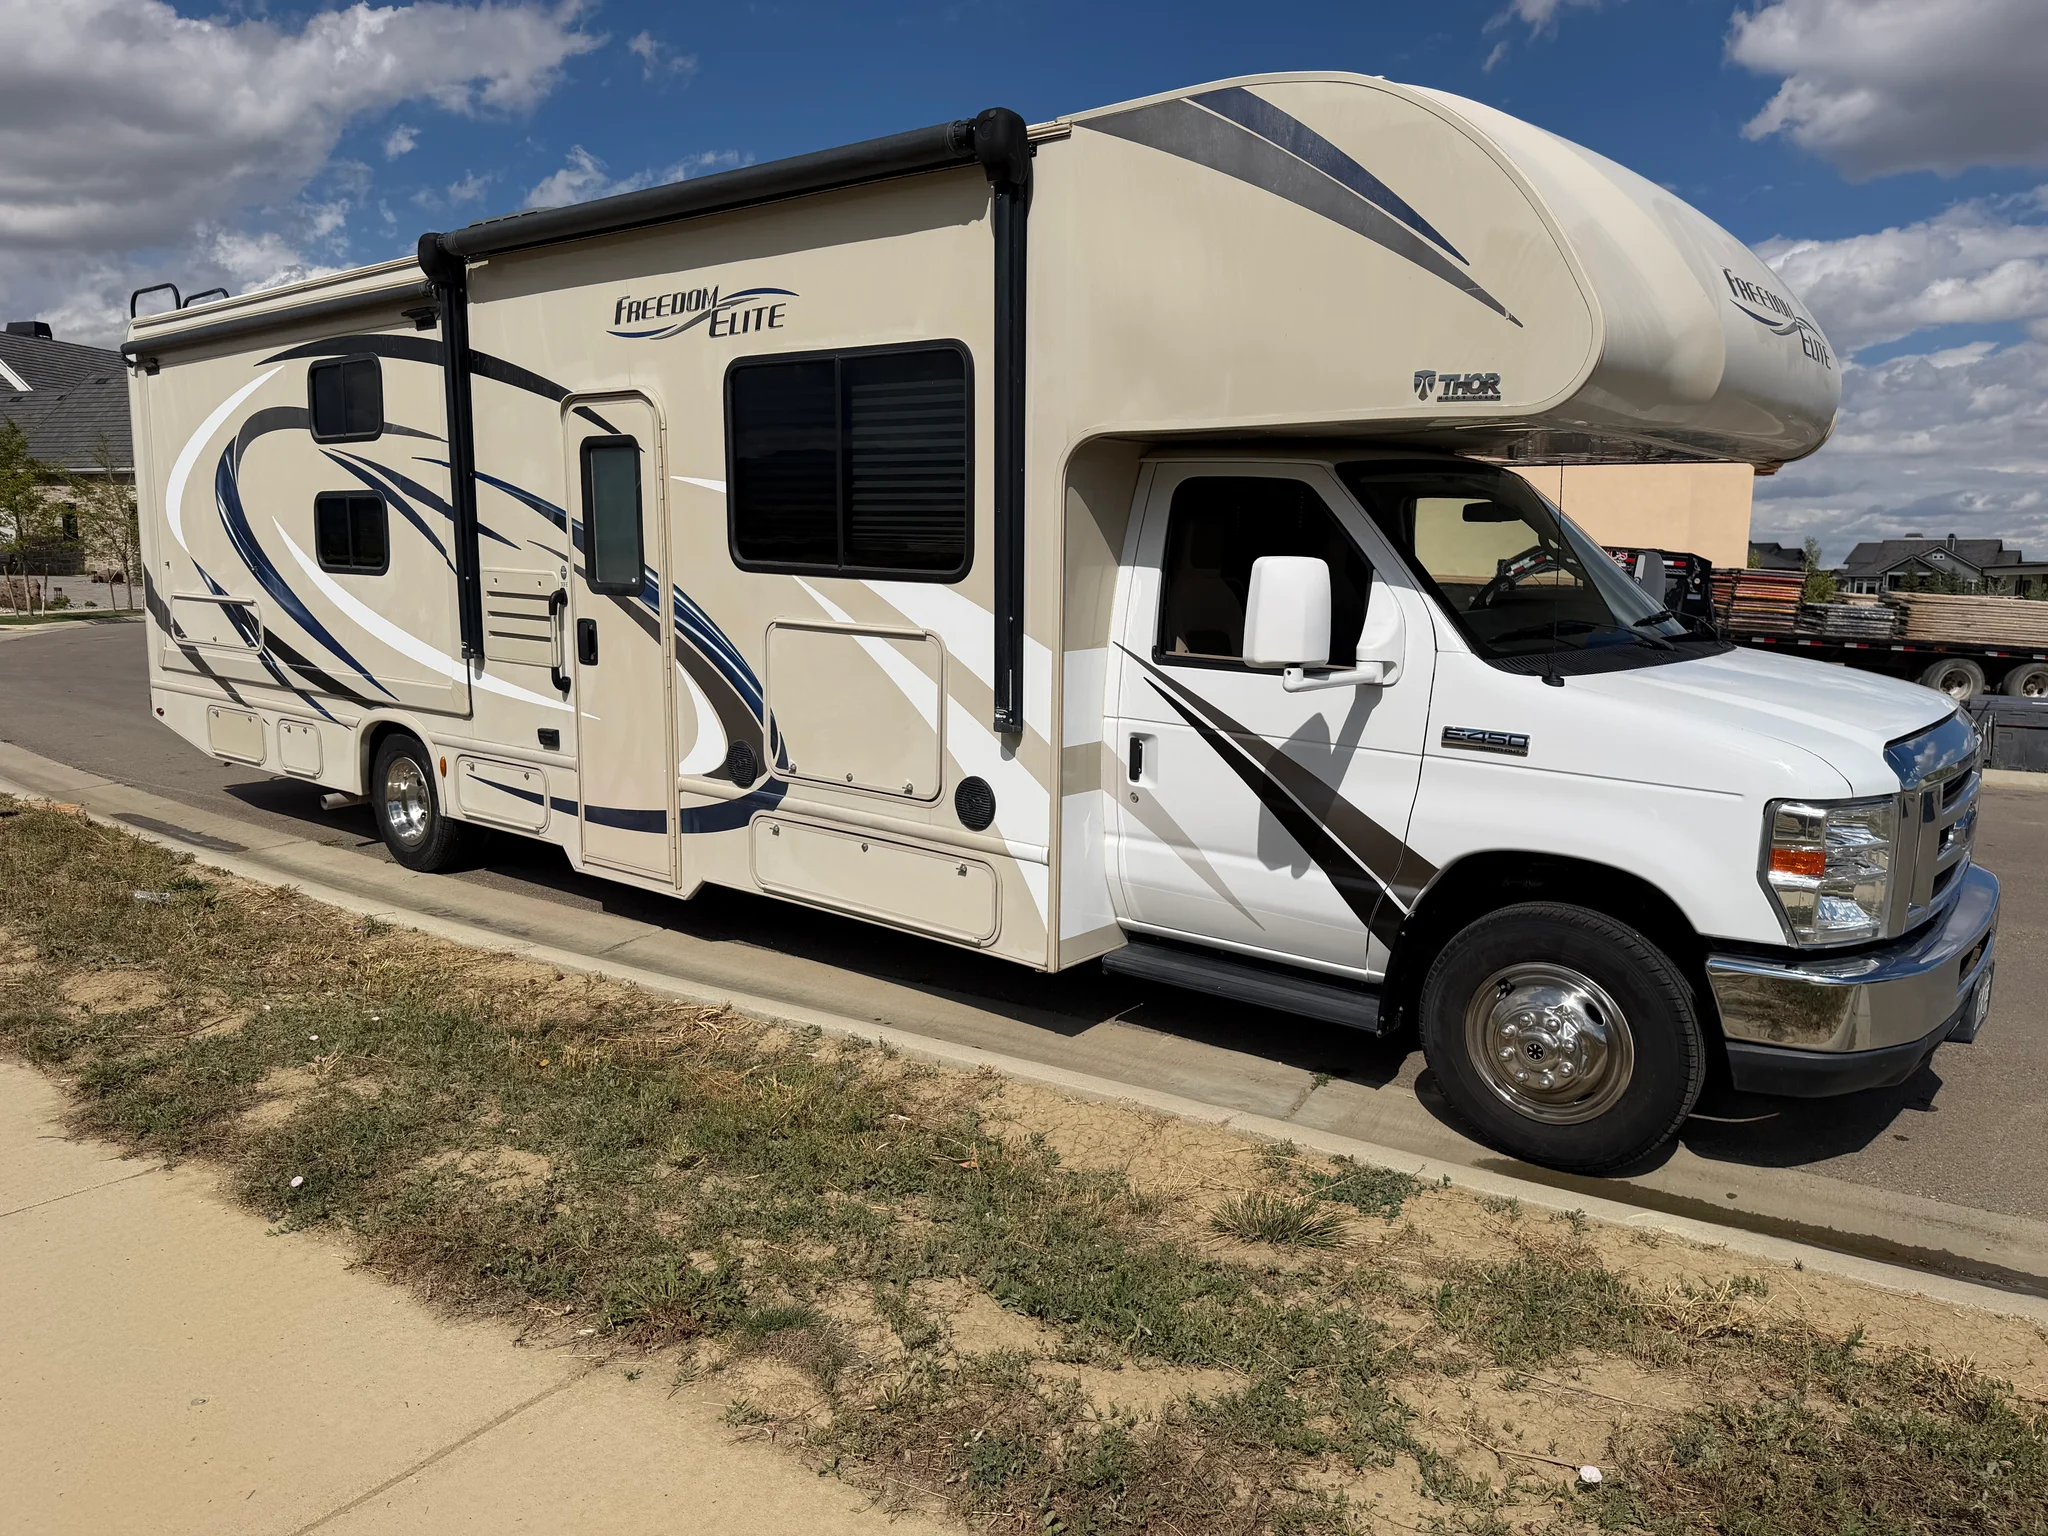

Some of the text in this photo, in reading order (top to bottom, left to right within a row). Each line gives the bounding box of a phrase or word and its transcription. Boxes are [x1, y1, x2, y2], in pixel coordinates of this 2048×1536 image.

[614, 284, 719, 325] FREEDOM
[1721, 266, 1796, 321] FREEDOM
[709, 303, 787, 339] ELITE
[1798, 325, 1831, 370] ELITE
[1438, 373, 1501, 395] THOR
[1443, 727, 1528, 748] E-450
